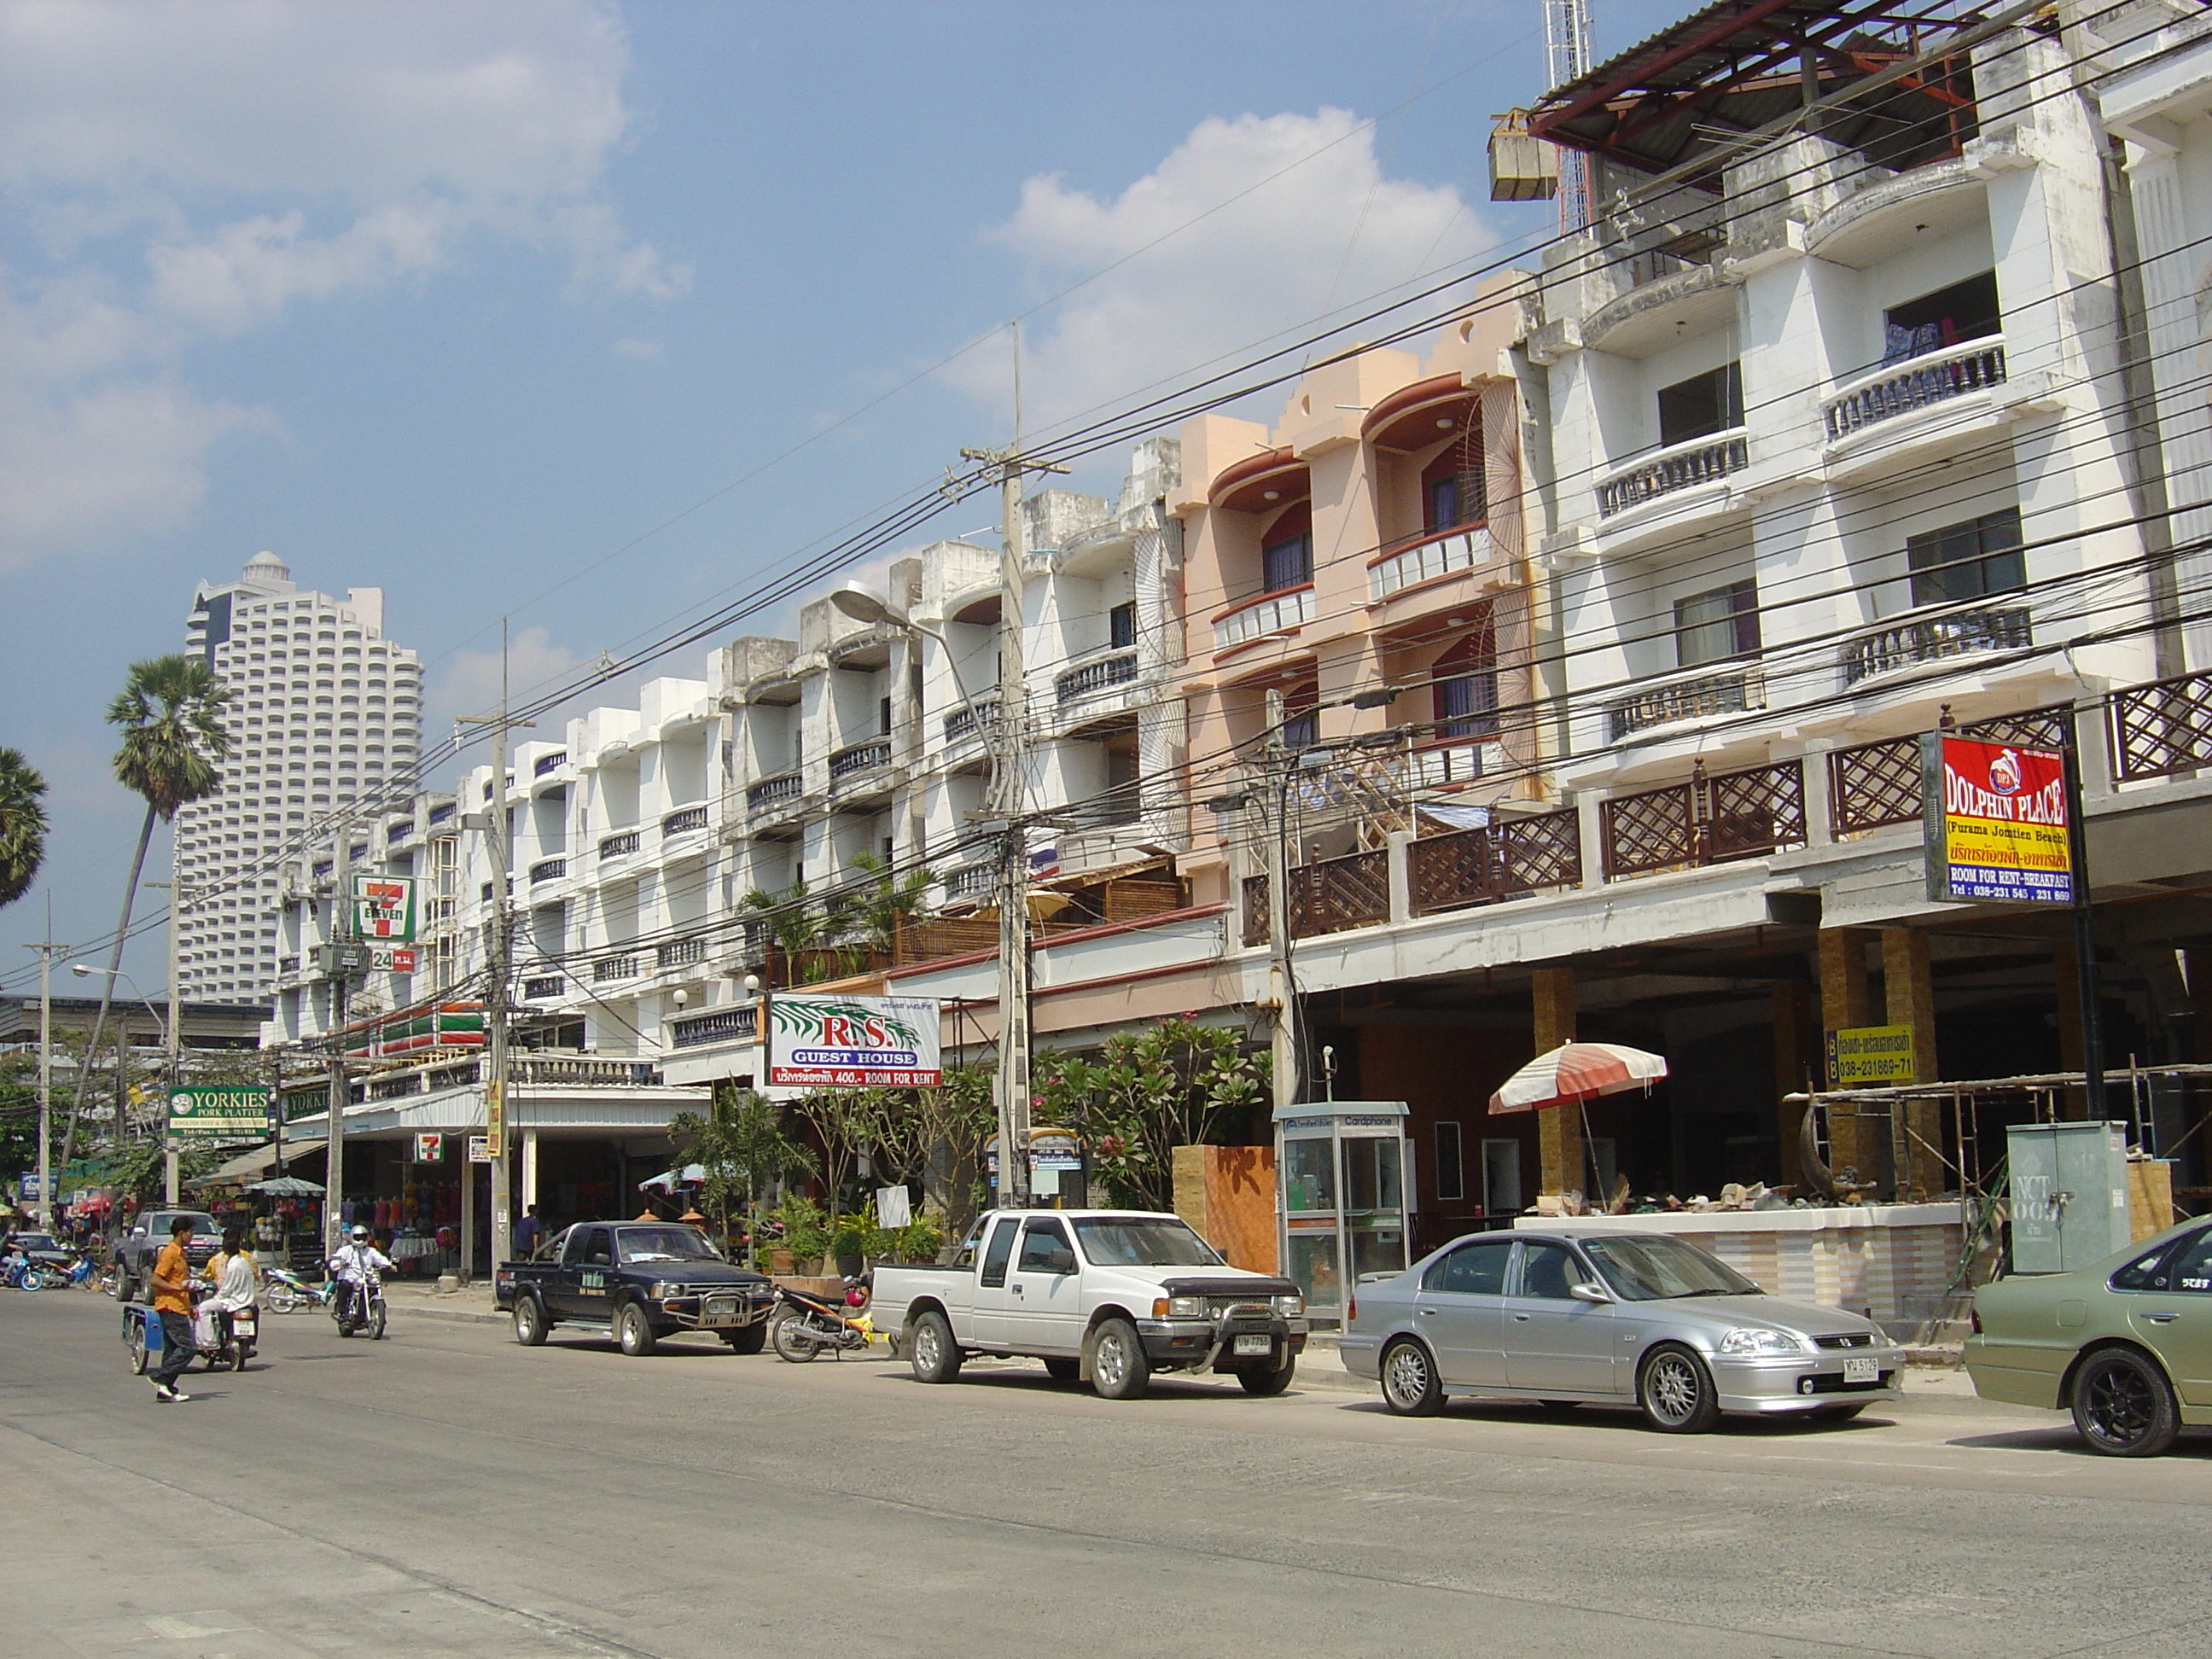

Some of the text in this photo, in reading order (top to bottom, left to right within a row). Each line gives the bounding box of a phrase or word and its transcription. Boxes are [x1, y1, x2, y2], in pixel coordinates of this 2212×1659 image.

[1945, 763, 2064, 825] DOLPHIN PLACE
[1947, 820, 2066, 846] (Furama Jomtien Beach)
[1951, 867, 2069, 888] ROOM FOR RENT-BREAKFAST
[1951, 884, 1965, 895] Tel
[1973, 885, 2009, 898] 038-231
[2036, 889, 2052, 900] 231
[373, 952, 393, 968] 24
[795, 1051, 916, 1065] GUEST HOUSE
[1839, 1058, 1912, 1076] 038-231869-71
[835, 1071, 863, 1085] 400.-
[864, 1072, 891, 1085] ROOM
[894, 1073, 911, 1085] FOR
[913, 1073, 935, 1086] RENT
[192, 1092, 268, 1109] YORKIES
[197, 1108, 265, 1118] PORK PLATTER
[1344, 1116, 1392, 1127] Cardphone
[2017, 1176, 2051, 1201] NCT
